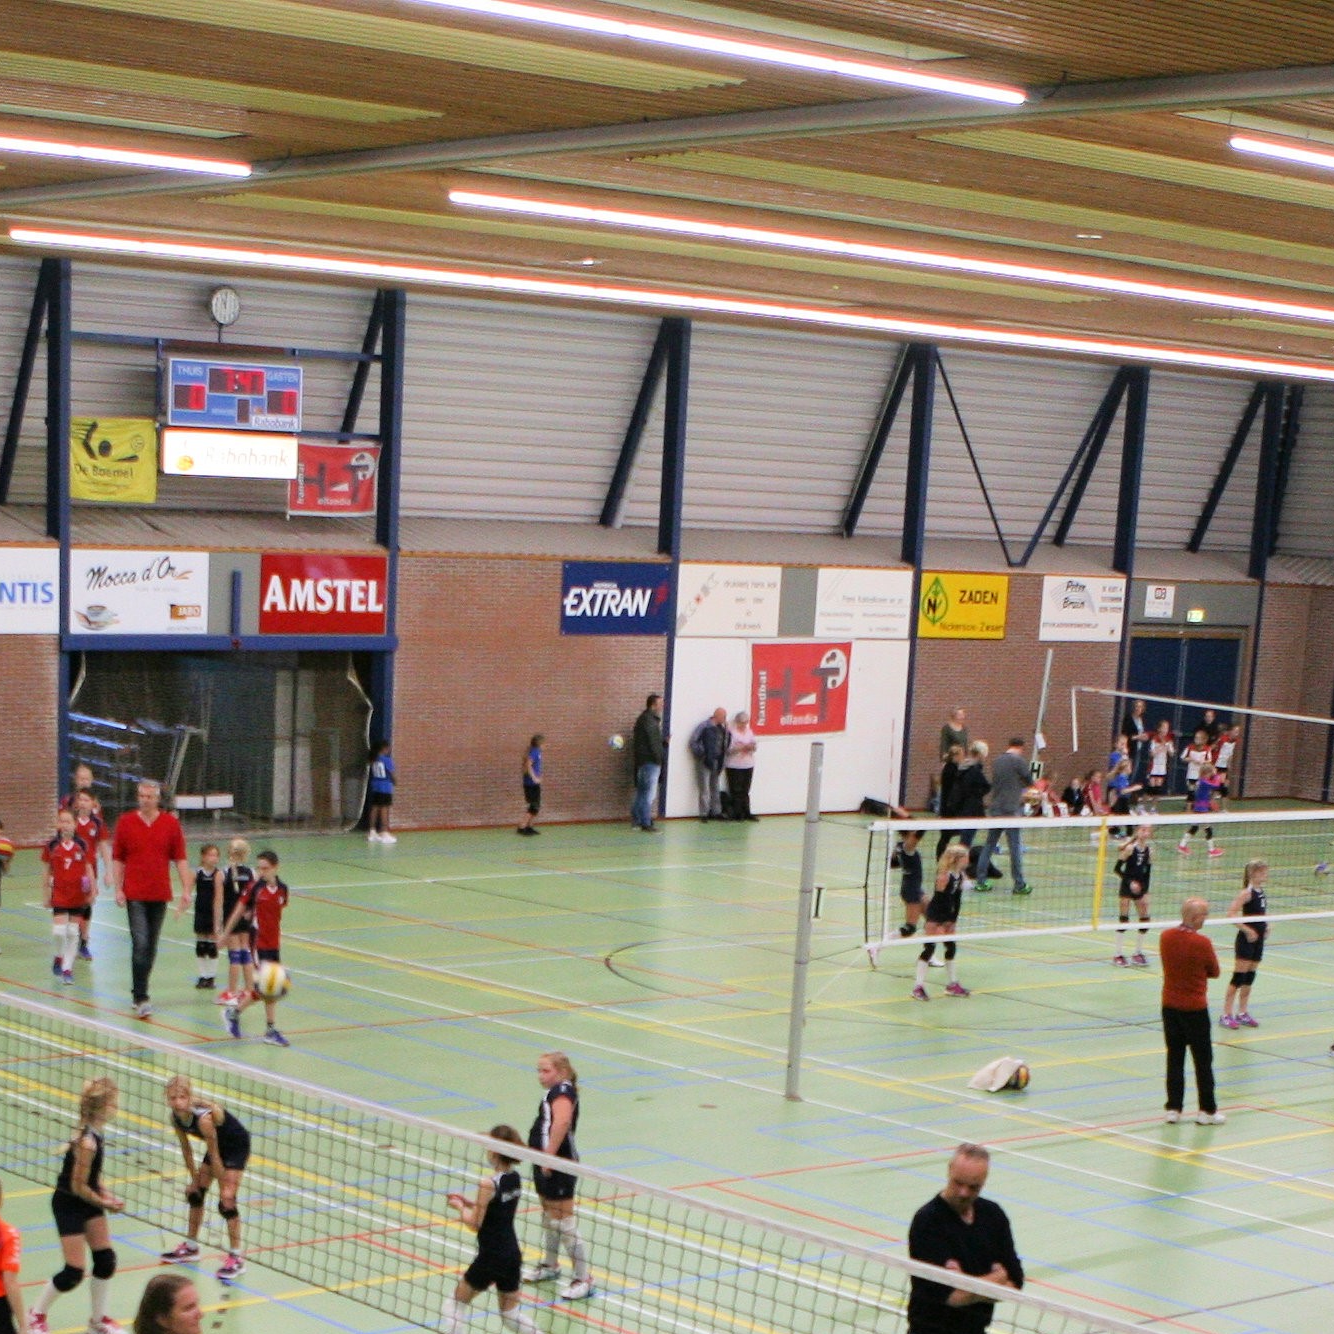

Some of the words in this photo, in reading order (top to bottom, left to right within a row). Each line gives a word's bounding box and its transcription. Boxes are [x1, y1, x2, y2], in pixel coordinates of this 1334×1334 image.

[263, 574, 384, 614] AMSTEL
[563, 588, 653, 617] EXTRAN
[959, 590, 998, 605] ZADEN
[1031, 762, 1041, 778] H
